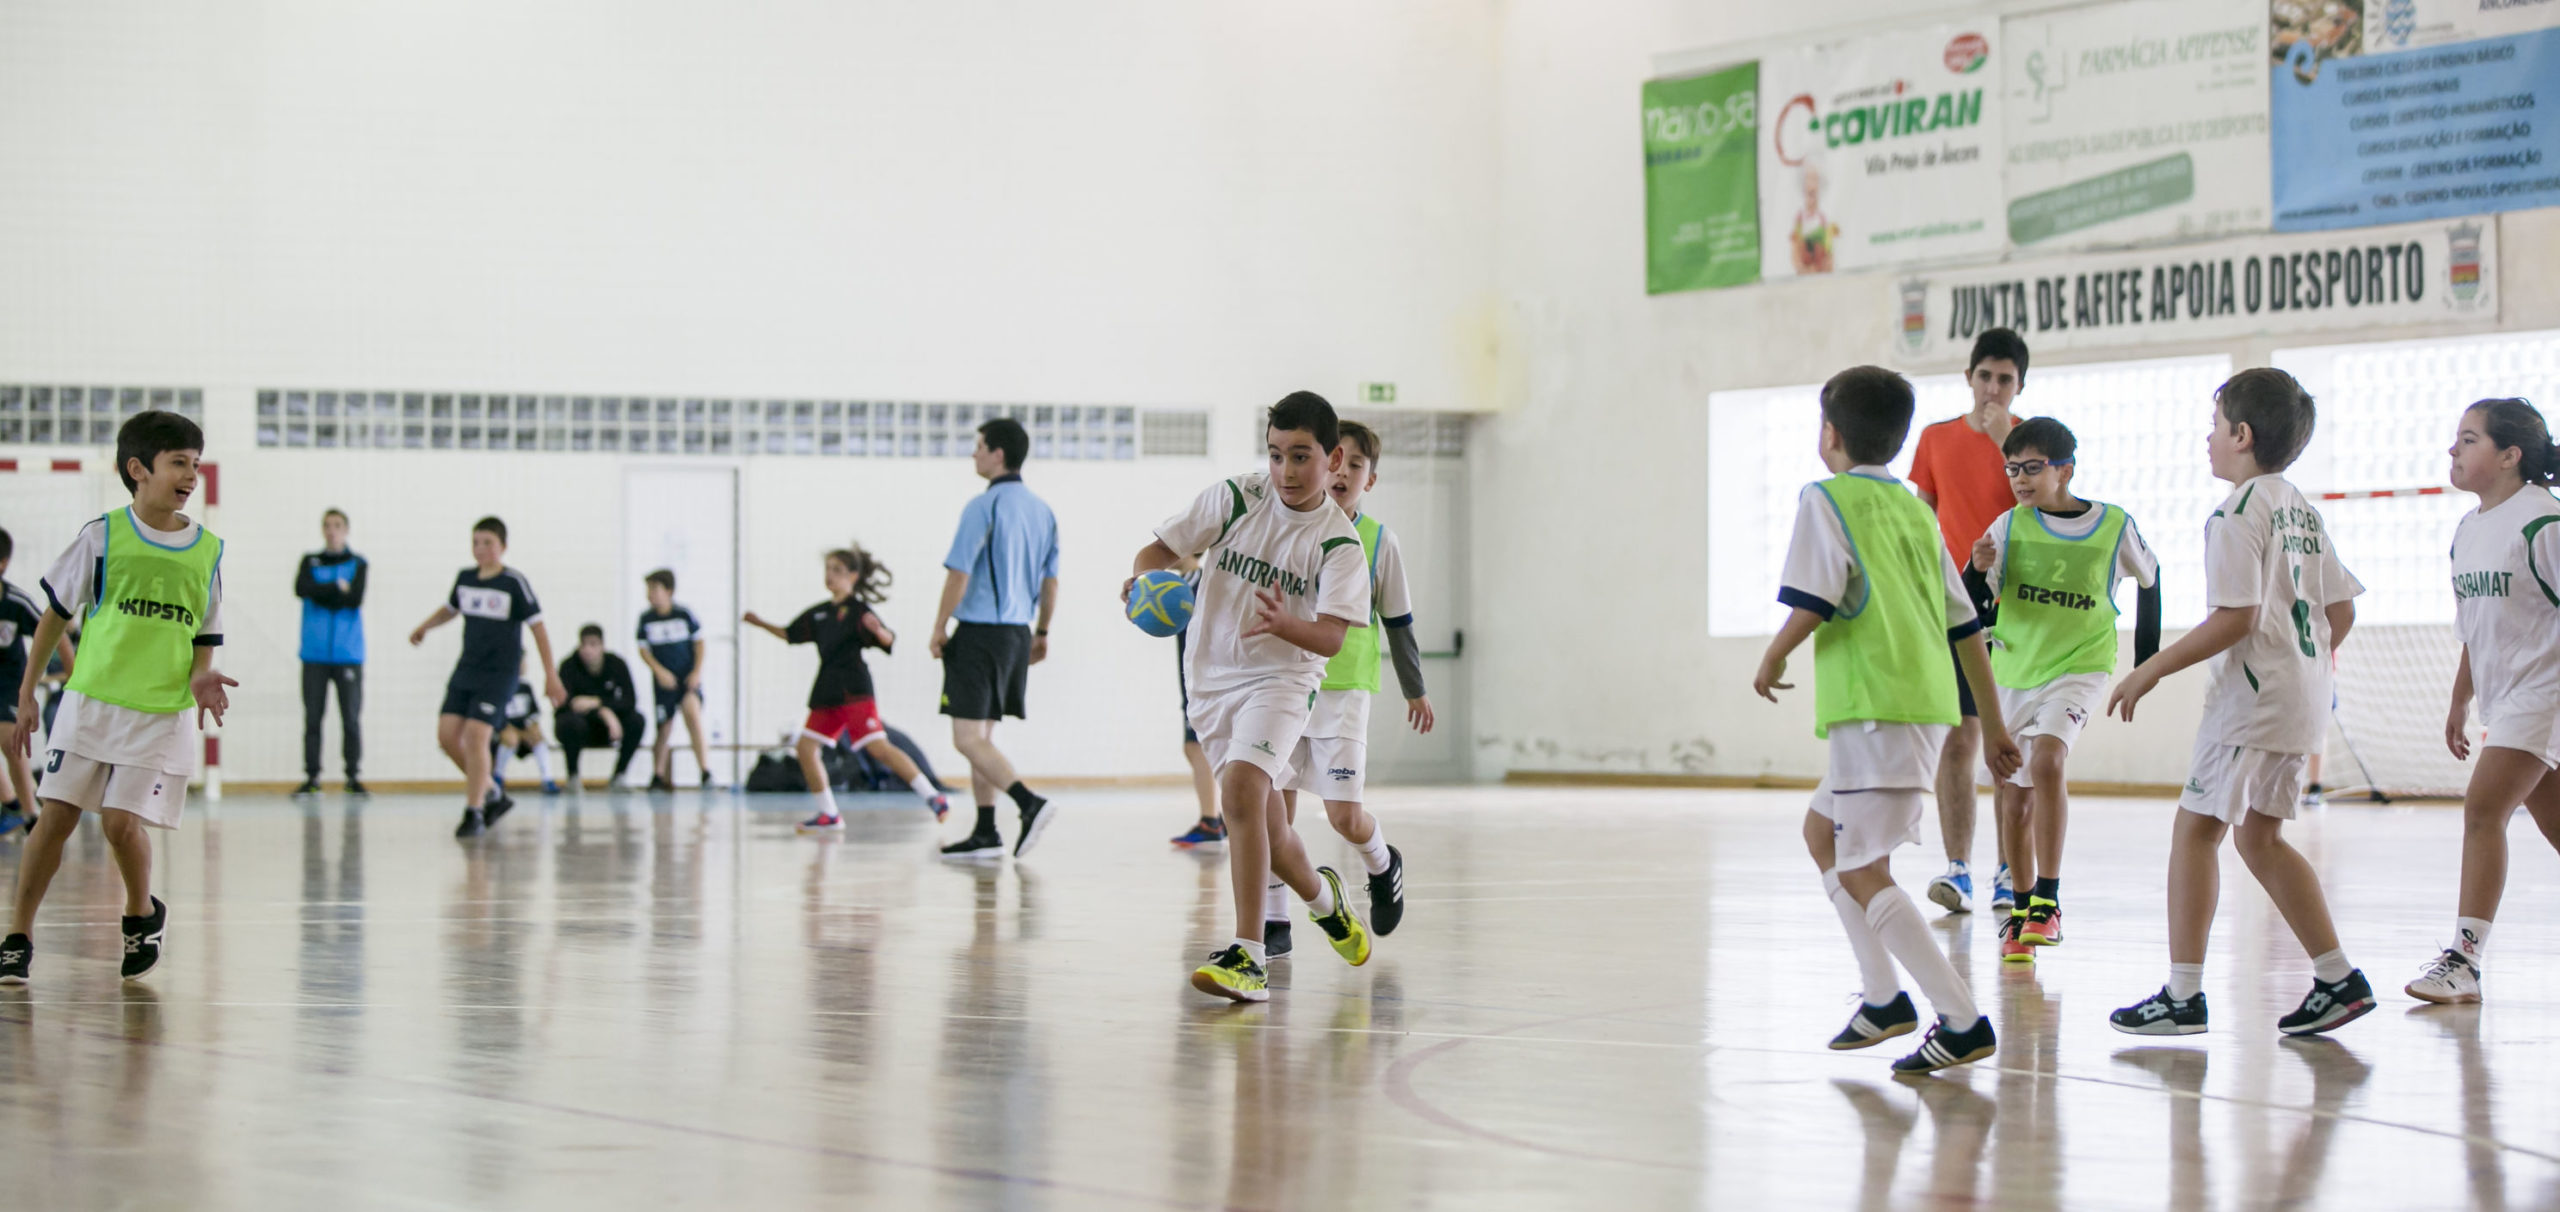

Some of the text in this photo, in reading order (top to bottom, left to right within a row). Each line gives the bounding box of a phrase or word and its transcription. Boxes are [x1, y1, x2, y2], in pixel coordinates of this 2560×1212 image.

[2431, 51, 2475, 69] ENSINO
[2384, 77, 2461, 99] PROFISSIONAIS
[1826, 86, 1983, 149] COVIRAN
[2464, 121, 2532, 144] FORMAÇÃO
[2410, 160, 2454, 180] CENTRO
[2454, 157, 2471, 173] DE
[2472, 148, 2543, 169] FORMAÇÃO
[1948, 240, 2425, 341] JUNTA DE AFIFE APOIA O DESPORTO
